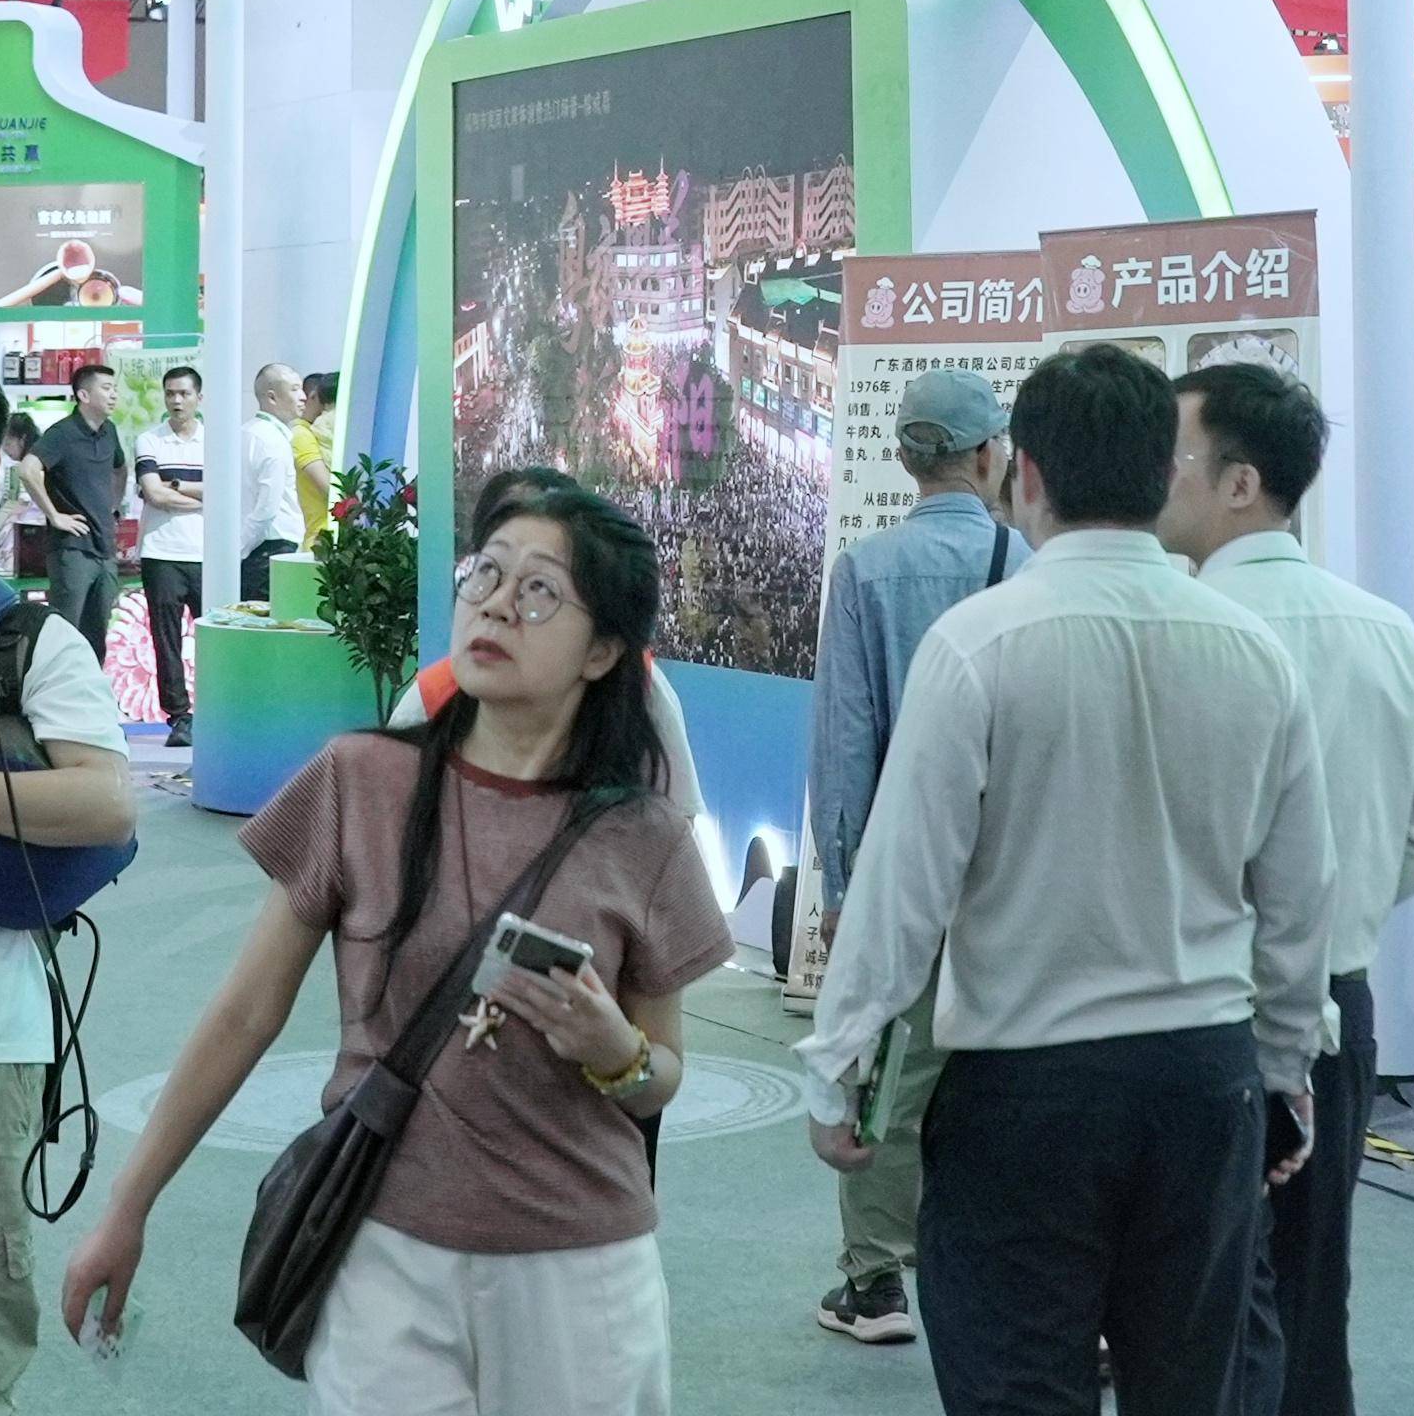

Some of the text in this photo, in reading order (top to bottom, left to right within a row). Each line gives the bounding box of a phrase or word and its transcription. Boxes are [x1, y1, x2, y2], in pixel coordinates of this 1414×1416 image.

[901, 277, 1043, 325] 公司简介
[1111, 247, 1290, 309] 产品介绍
